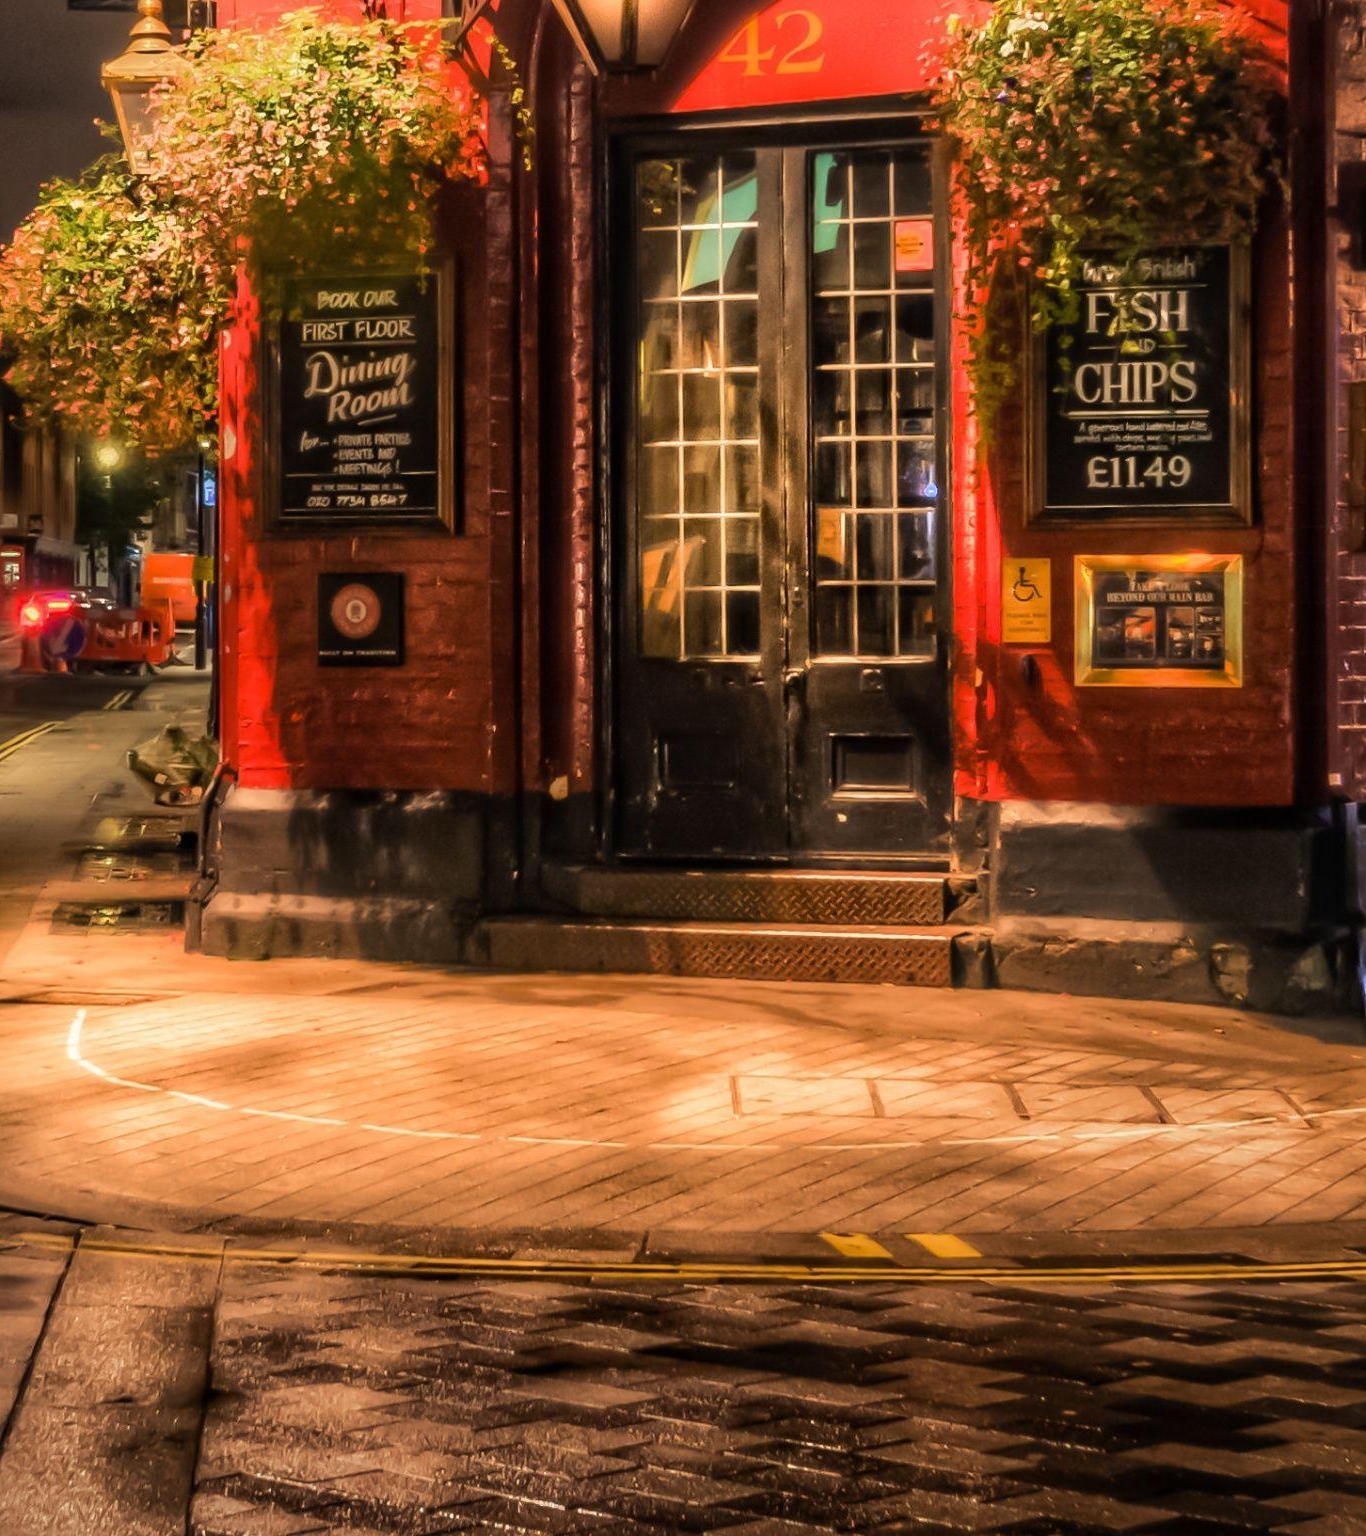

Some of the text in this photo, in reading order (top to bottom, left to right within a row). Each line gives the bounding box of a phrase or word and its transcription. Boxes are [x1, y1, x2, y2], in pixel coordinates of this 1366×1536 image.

[721, 10, 826, 77] 42
[317, 289, 399, 311] BOOK OUR
[301, 319, 416, 341] FIRST FLOOR
[303, 350, 417, 400] Dining
[1074, 361, 1197, 404] CHIPS
[1087, 455, 1192, 488] £11.49
[1107, 592, 1145, 602] BEYOND
[1147, 592, 1167, 602] OUR
[1195, 592, 1213, 602] BAR
